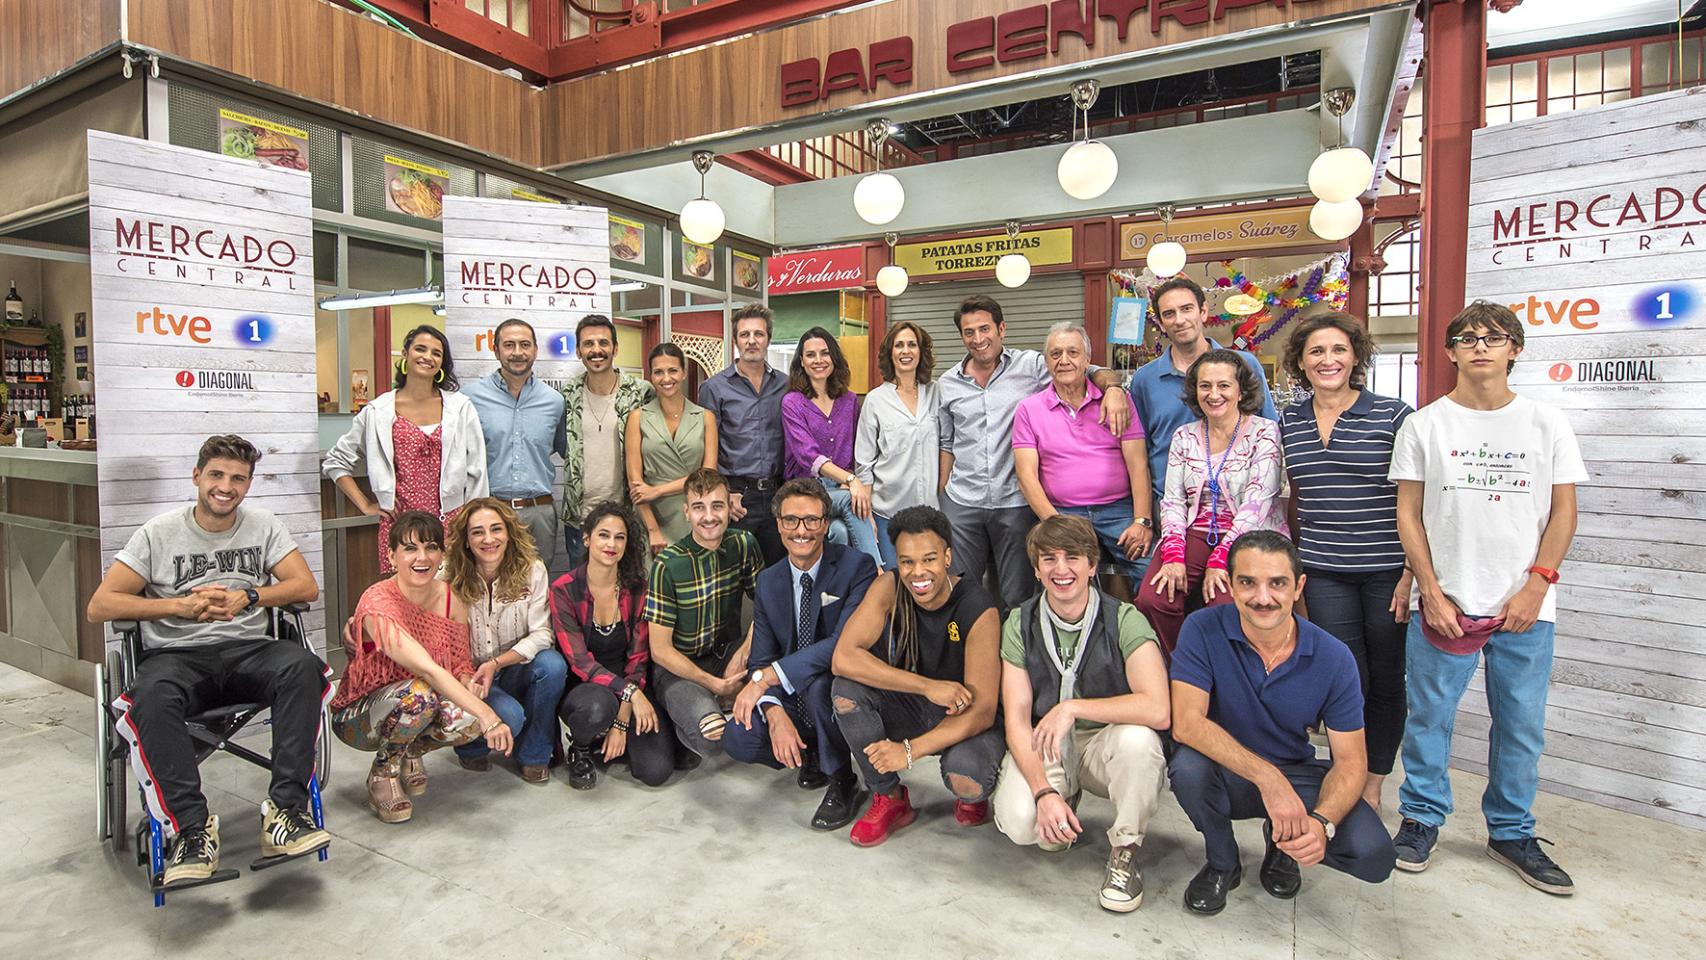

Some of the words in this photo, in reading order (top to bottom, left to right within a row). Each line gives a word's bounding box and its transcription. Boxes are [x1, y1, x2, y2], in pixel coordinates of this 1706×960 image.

[781, 36, 913, 109] BAR
[947, 0, 1323, 73] CENTR
[115, 217, 296, 268] MERCADO
[1152, 228, 1233, 244] Caramelos
[1239, 220, 1300, 239] Suárez
[921, 242, 983, 259] PATATAS
[986, 236, 1041, 252] FRITAS
[936, 253, 1013, 270] TORREZ
[1492, 231, 1696, 265] CENTRA
[117, 258, 297, 290] CENTRAL
[461, 261, 597, 290] MERCADO
[785, 258, 862, 287] Verduras
[462, 292, 597, 309] CENTRAL
[1656, 292, 1674, 319] 1
[136, 306, 212, 344] rtve
[249, 320, 262, 342] 1
[475, 329, 497, 353] rt
[559, 335, 570, 354] 1
[198, 371, 254, 390] DIAGONAL
[1578, 360, 1657, 382] DIAGONAL
[173, 545, 263, 590] LE-WIN
